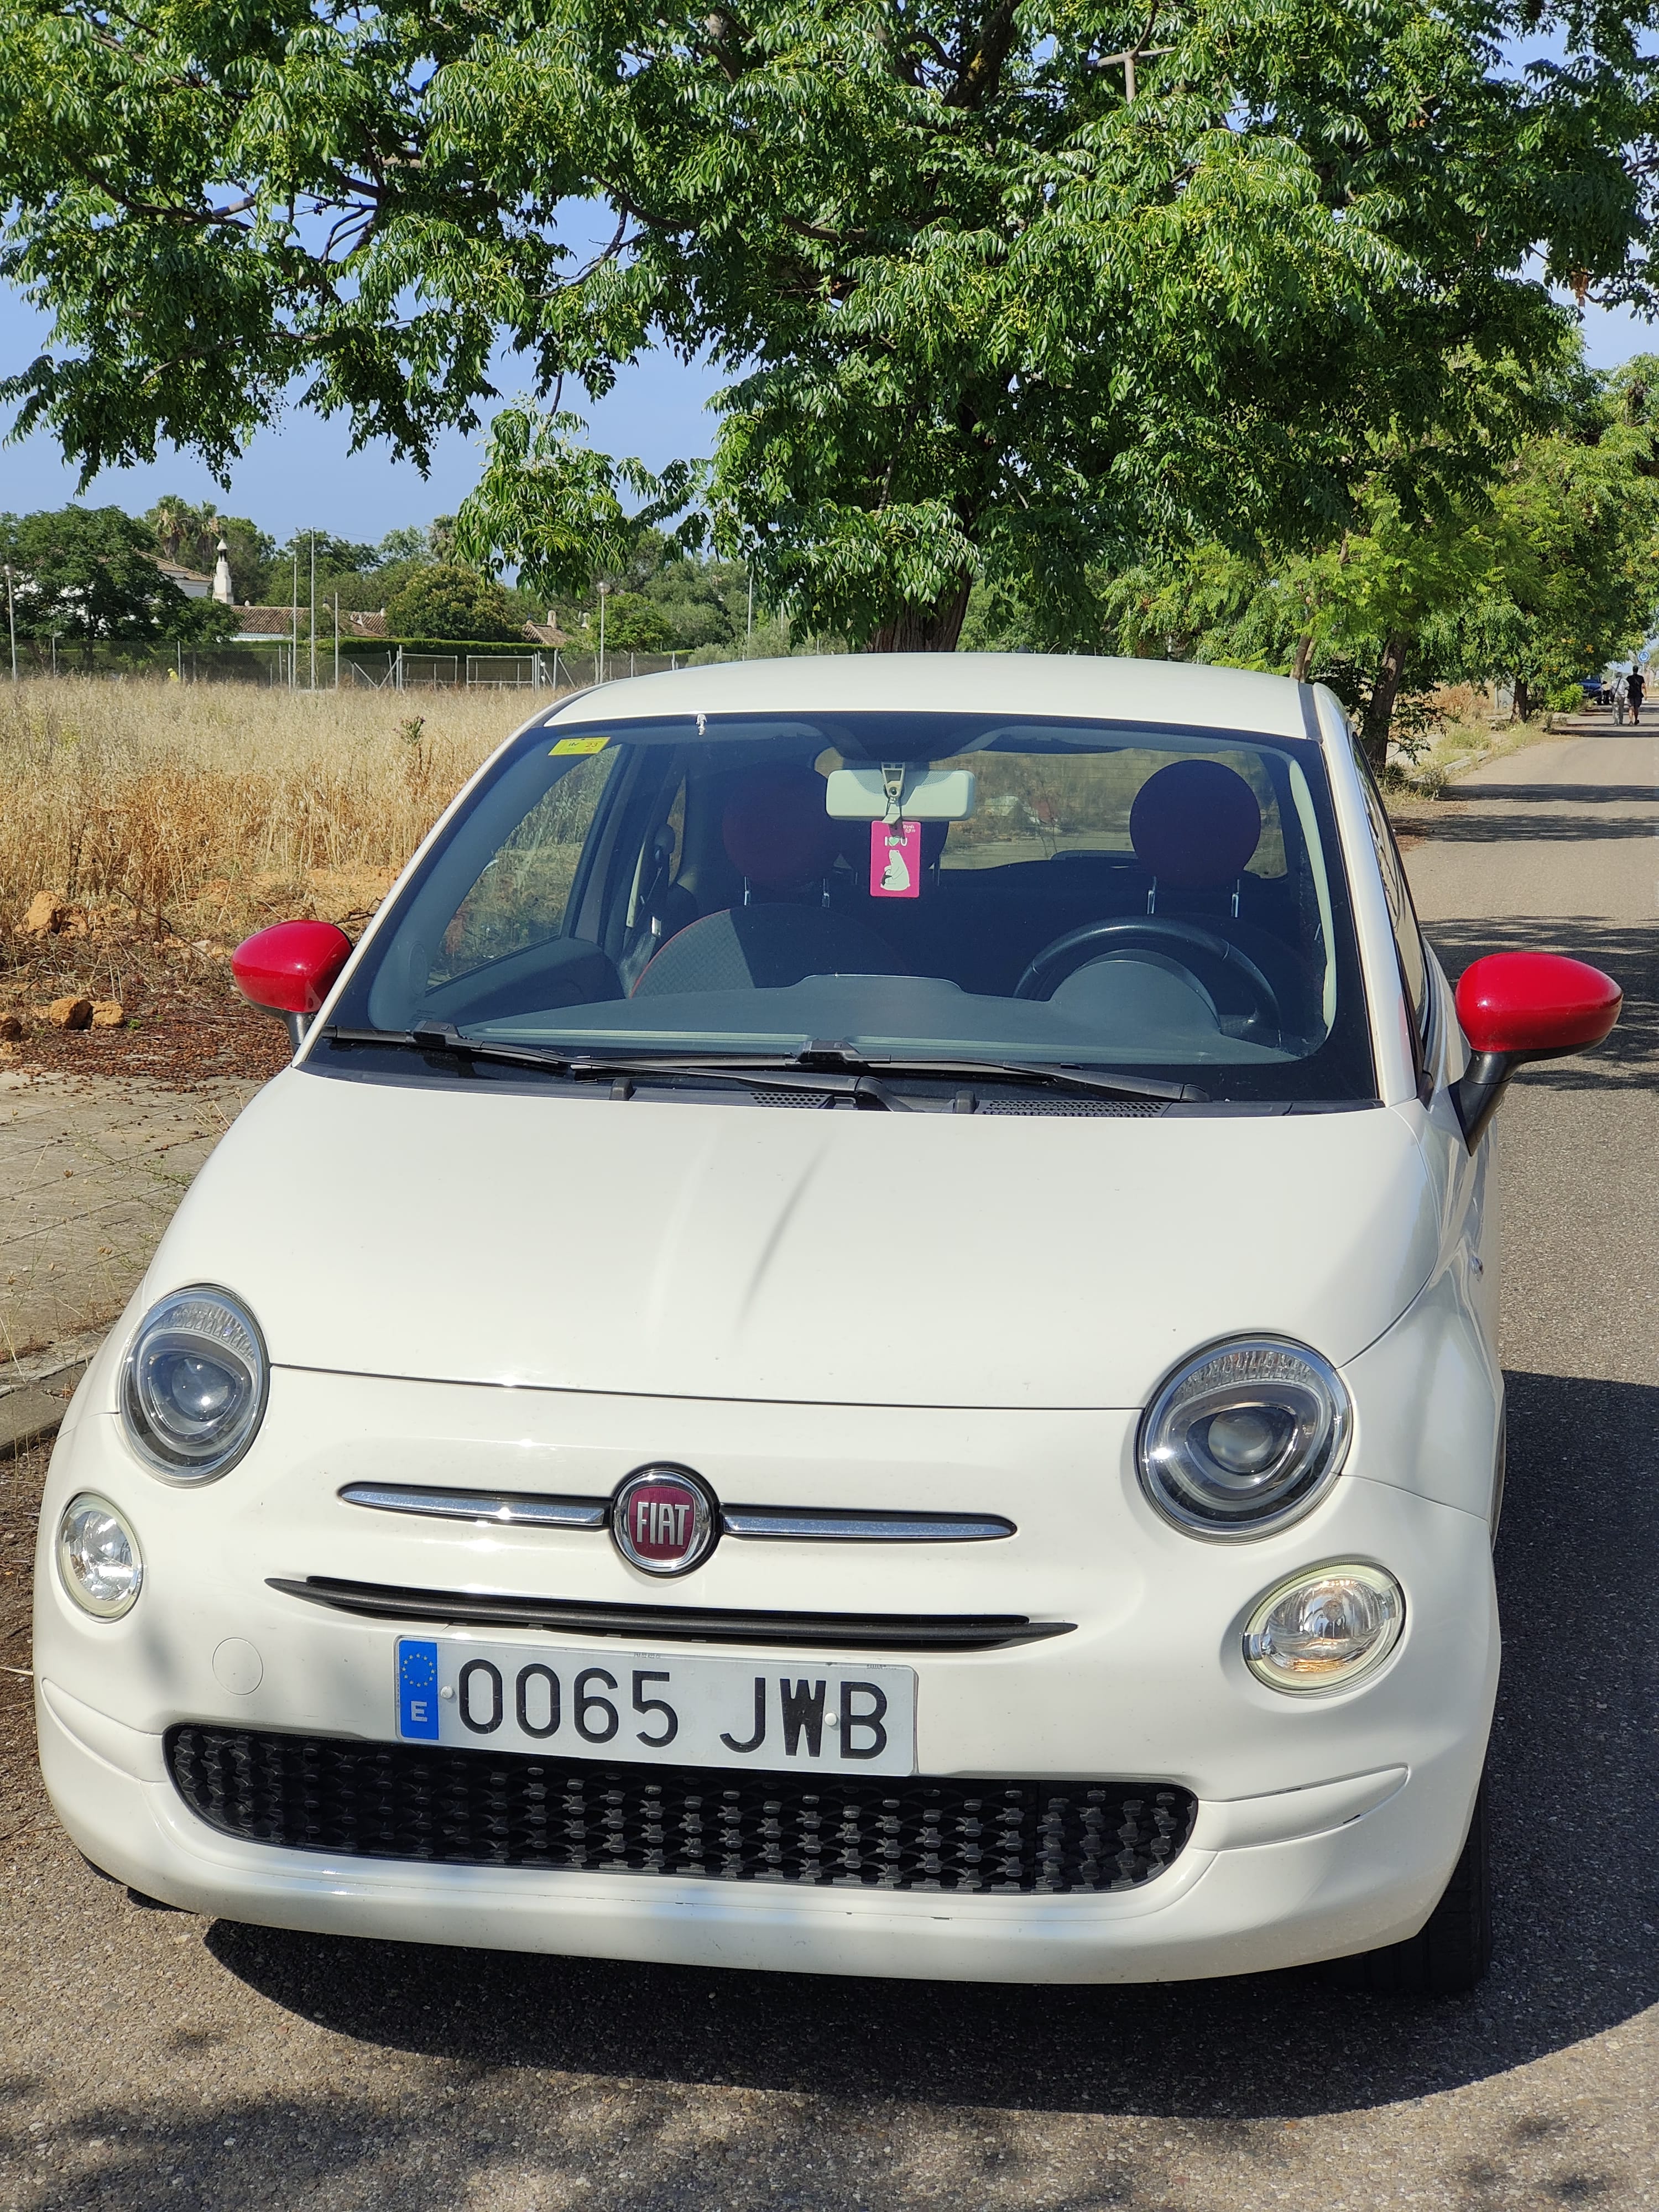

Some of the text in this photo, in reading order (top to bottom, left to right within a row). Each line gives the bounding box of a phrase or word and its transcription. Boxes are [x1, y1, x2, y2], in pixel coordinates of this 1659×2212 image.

[900, 837, 908, 847] U
[637, 1501, 690, 1546] FIAT
[410, 1700, 428, 1722] E
[458, 1658, 678, 1747] 0065
[719, 1677, 888, 1760] JWB
